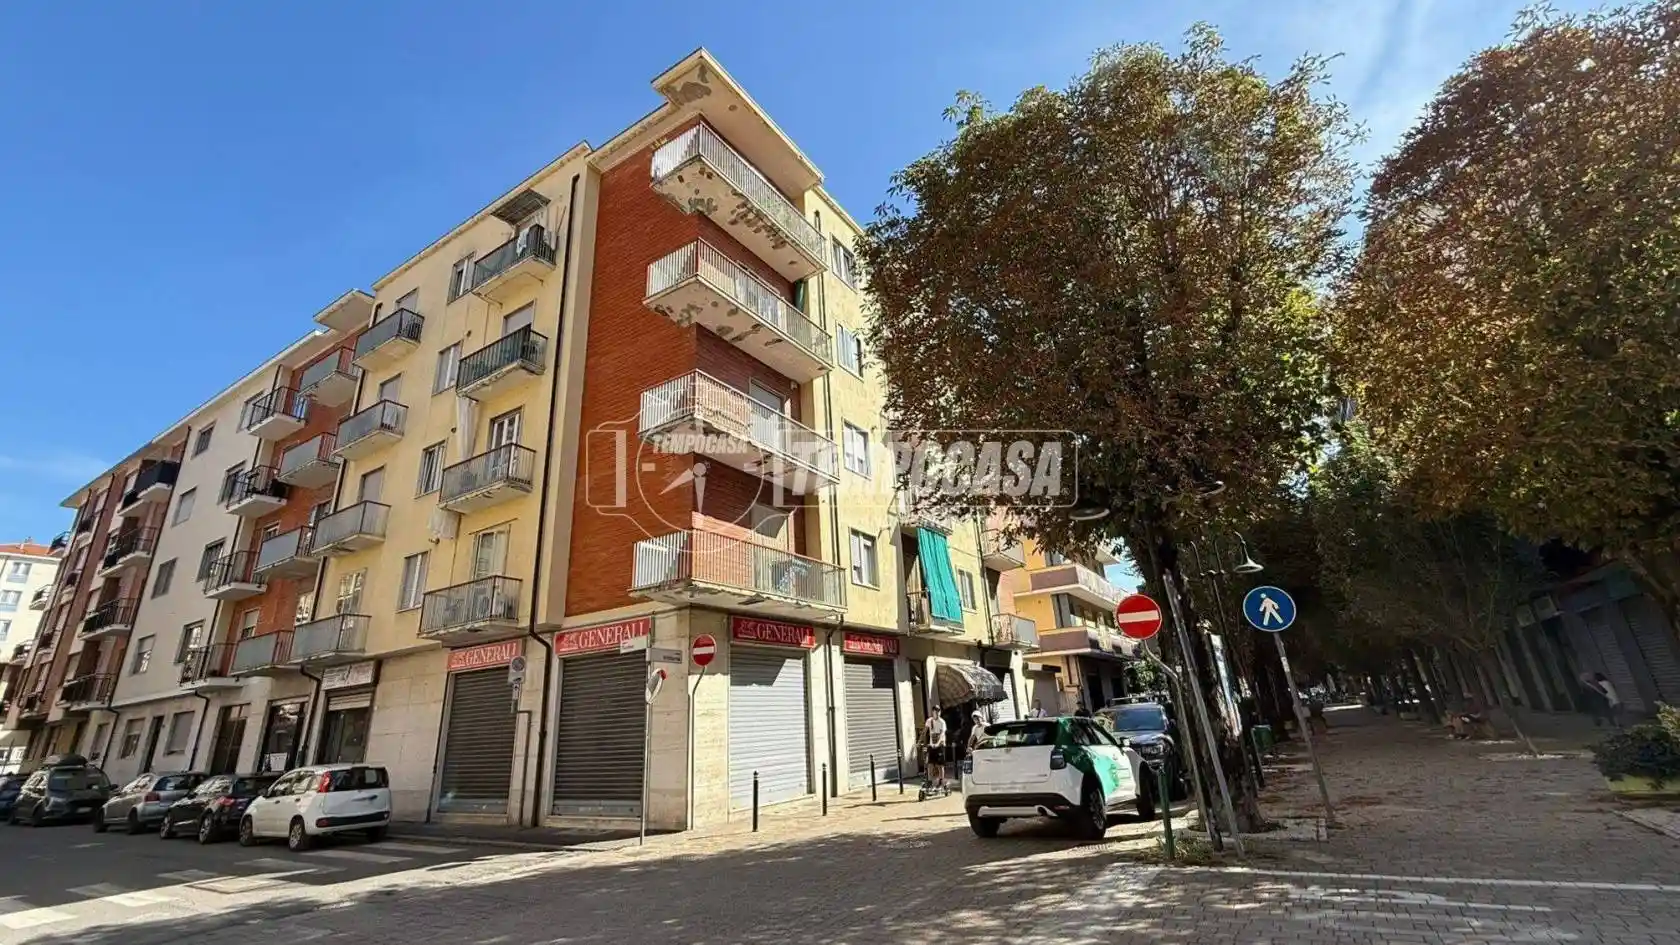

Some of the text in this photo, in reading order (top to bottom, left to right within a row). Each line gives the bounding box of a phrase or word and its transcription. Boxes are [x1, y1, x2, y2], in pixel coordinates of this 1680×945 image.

[578, 621, 644, 649] GENERALI
[756, 623, 812, 645] GENERALI
[465, 642, 517, 666] GENERALI
